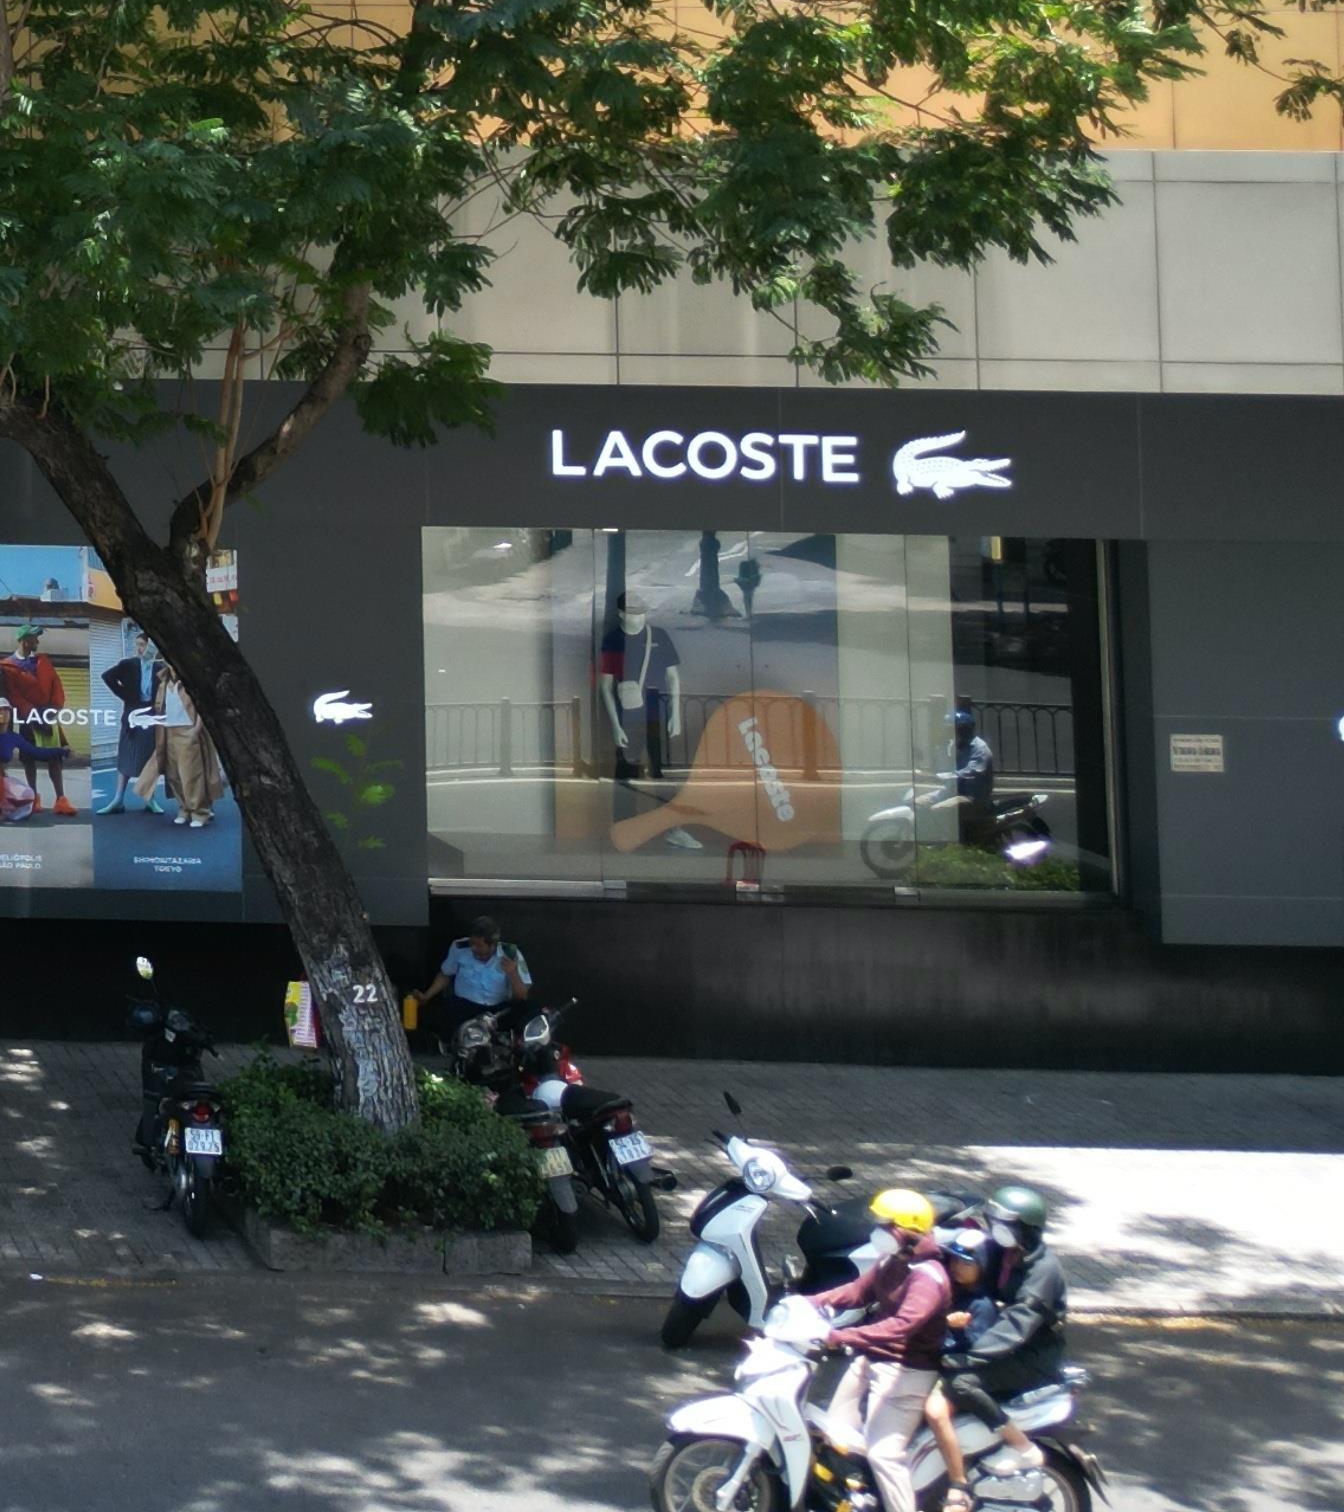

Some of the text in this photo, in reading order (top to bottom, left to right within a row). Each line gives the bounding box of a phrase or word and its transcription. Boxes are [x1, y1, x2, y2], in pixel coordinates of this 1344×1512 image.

[551, 429, 860, 483] LACOSTE
[12, 707, 117, 726] LACOSTE
[737, 717, 795, 822] Lacoste
[352, 983, 378, 1004] 22
